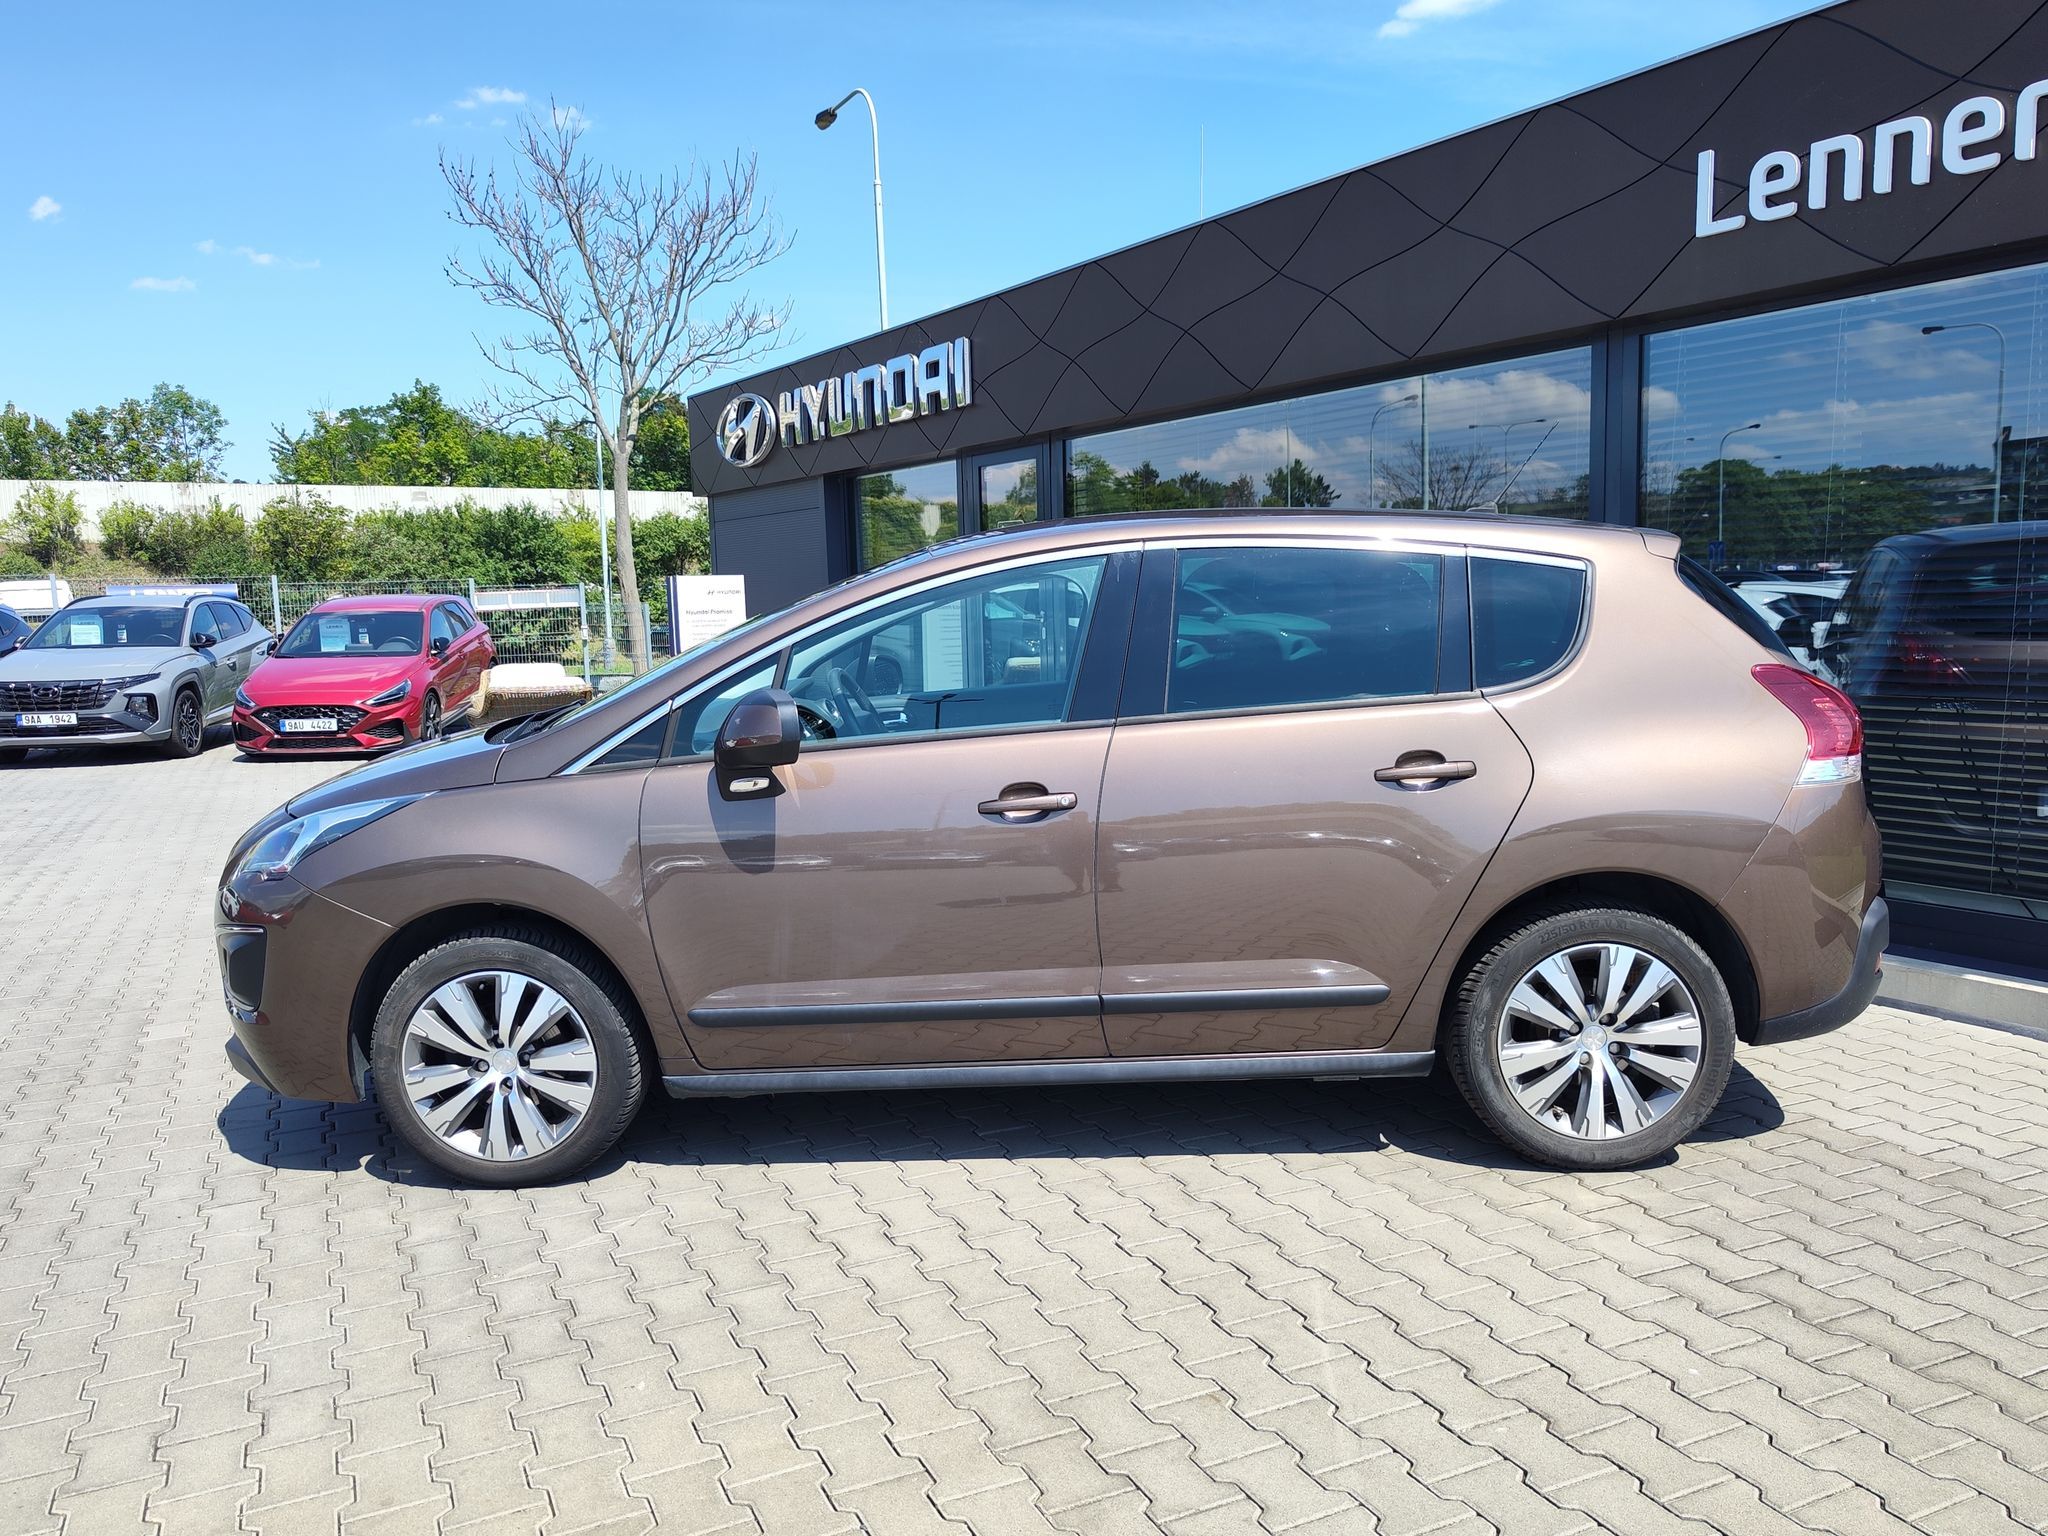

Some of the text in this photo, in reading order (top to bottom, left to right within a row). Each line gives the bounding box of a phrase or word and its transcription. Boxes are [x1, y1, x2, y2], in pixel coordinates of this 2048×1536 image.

[779, 336, 973, 448] HYUNDAI
[24, 714, 73, 724] 9AA 1942
[287, 720, 333, 730] 9AU 4422
